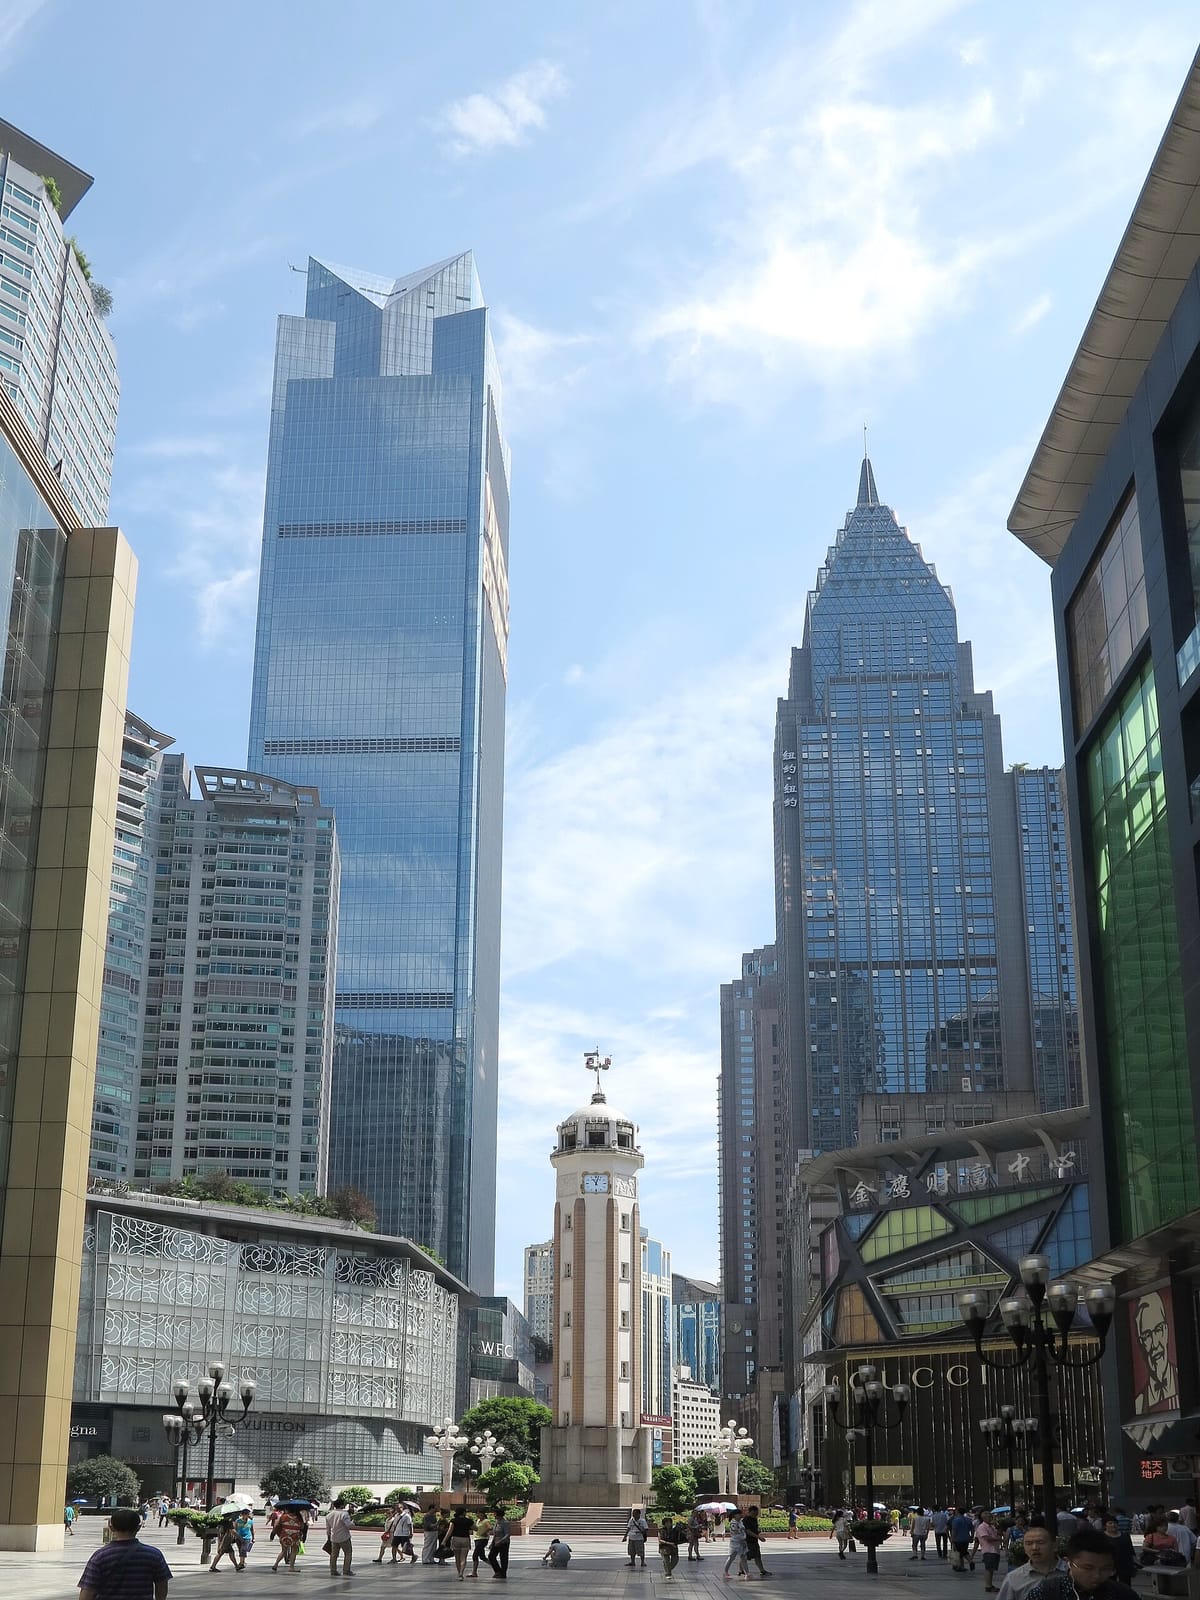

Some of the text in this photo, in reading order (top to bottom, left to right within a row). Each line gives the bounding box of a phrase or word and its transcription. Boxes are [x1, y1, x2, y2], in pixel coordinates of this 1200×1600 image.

[850, 1152, 1076, 1204] 金鹰财富中心
[481, 1340, 513, 1358] WFC
[69, 1424, 98, 1438] gna
[1141, 1470, 1163, 1479] 地产
